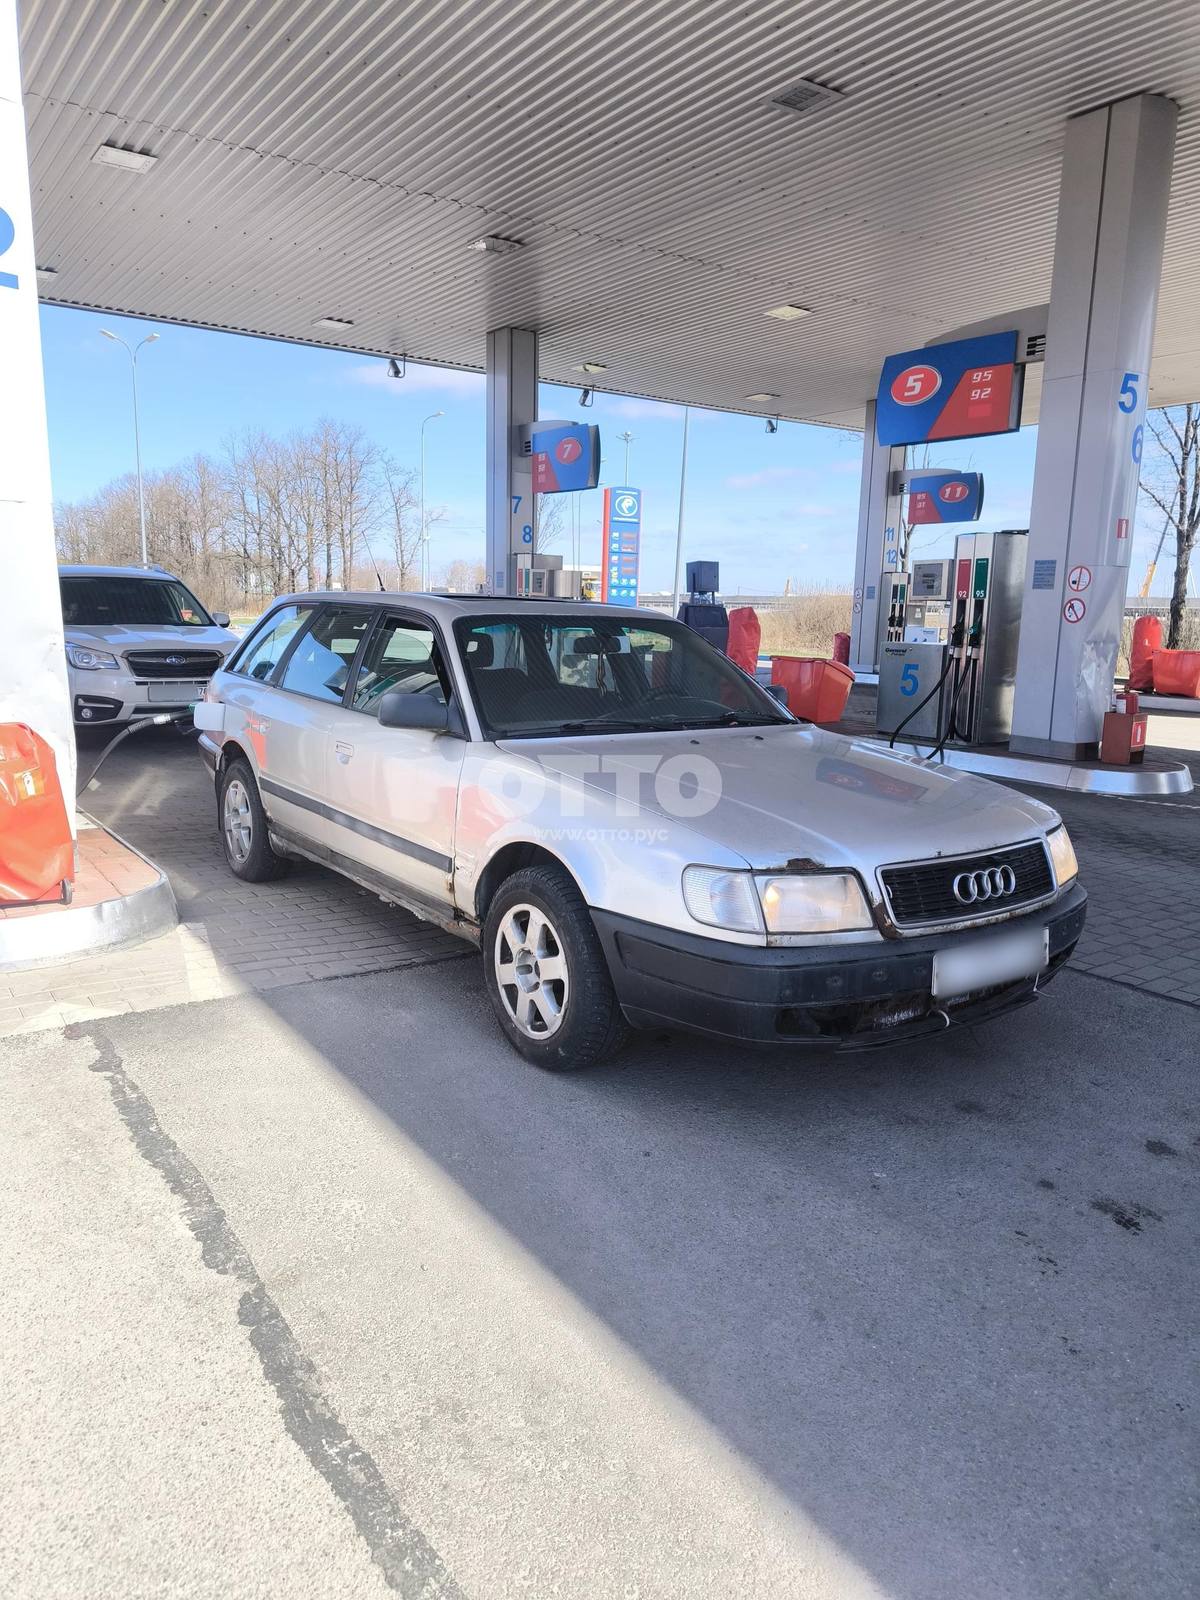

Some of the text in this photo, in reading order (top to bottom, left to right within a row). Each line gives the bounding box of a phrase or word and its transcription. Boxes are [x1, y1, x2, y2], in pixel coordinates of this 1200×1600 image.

[971, 370, 993, 383] 95
[903, 374, 925, 397] 5
[970, 388, 992, 400] 92
[1118, 373, 1139, 414] 5
[563, 444, 573, 458] 7
[1131, 424, 1144, 465] 6
[944, 486, 963, 498] 11
[512, 496, 522, 514] 7
[522, 525, 532, 544] 8
[885, 527, 895, 541] 11
[886, 549, 897, 564] 12
[958, 590, 967, 598] 92
[975, 590, 985, 598] 95
[900, 663, 919, 696] 5
